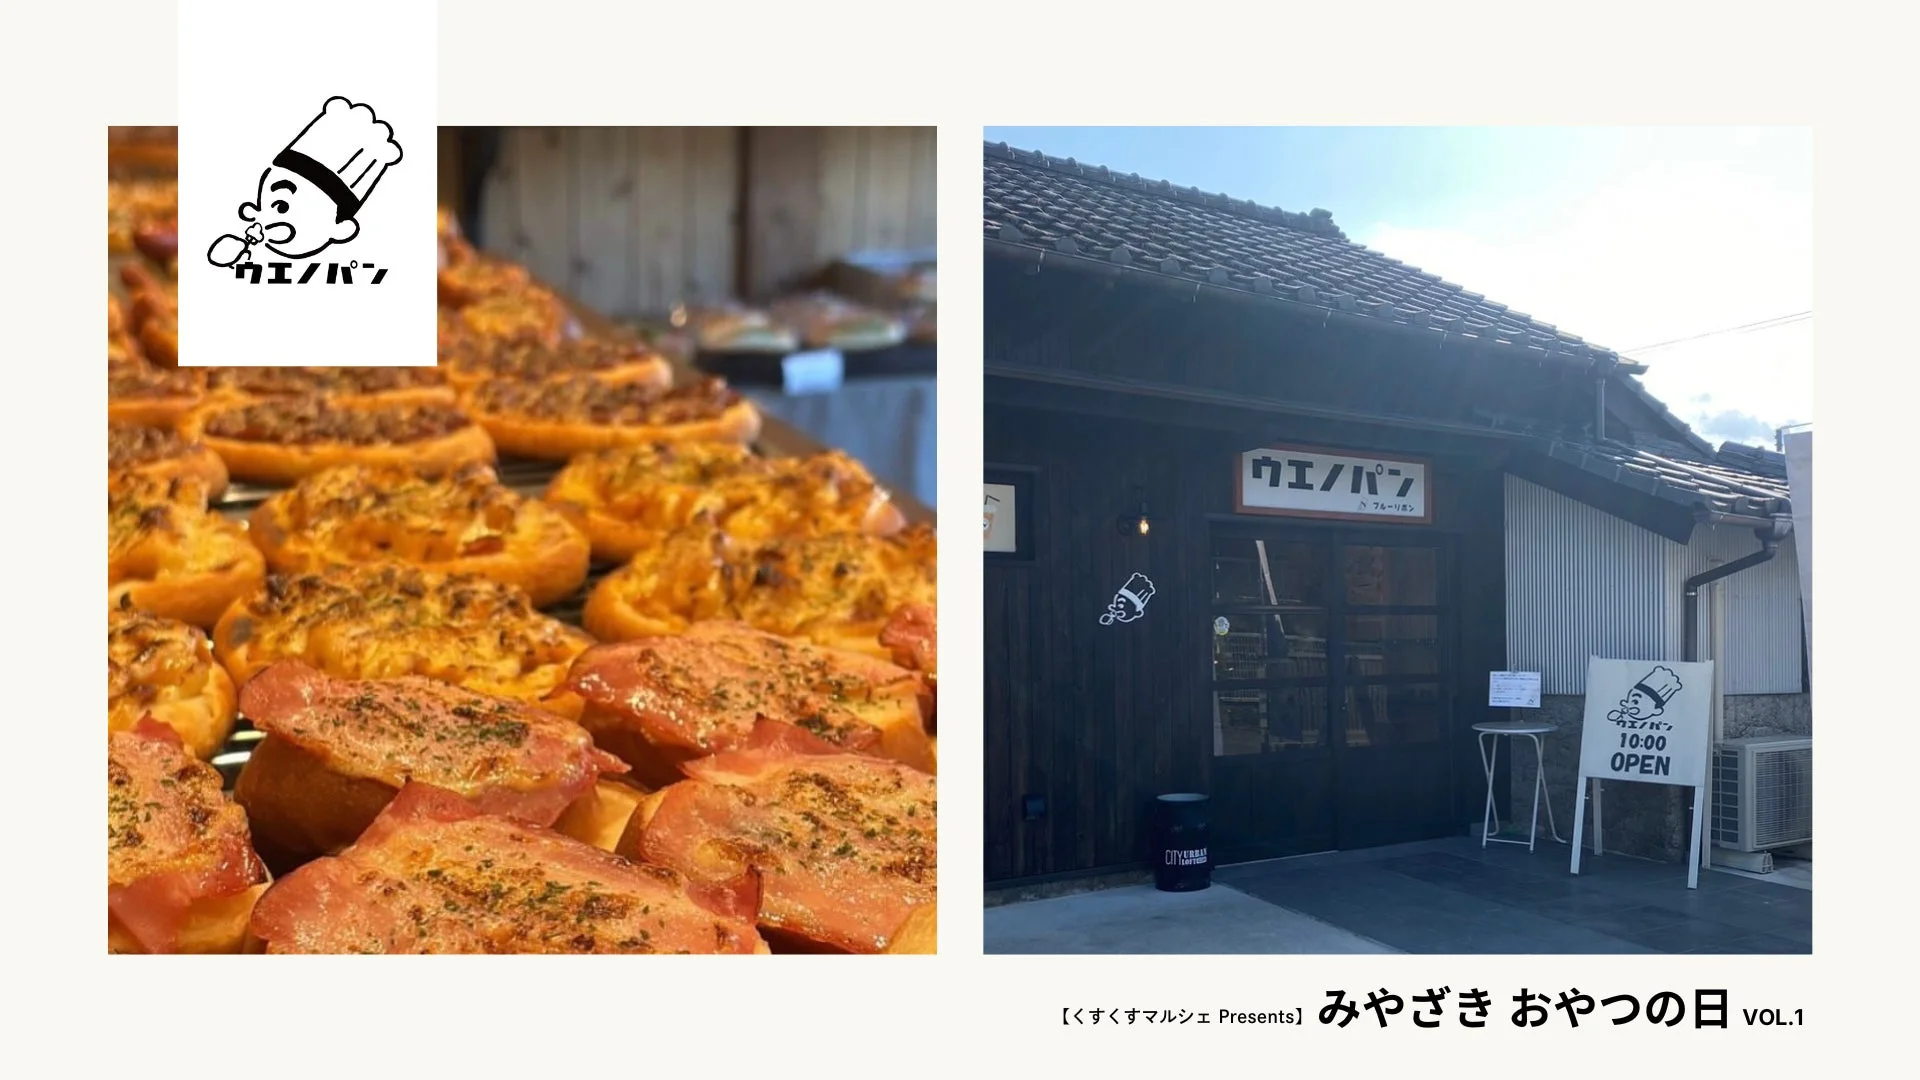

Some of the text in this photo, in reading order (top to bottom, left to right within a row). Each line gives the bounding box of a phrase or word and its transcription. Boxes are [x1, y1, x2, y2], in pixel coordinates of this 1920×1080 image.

[1252, 456, 1414, 497] ウエノパン
[1616, 720, 1673, 731] ウエノパン
[1620, 732, 1667, 751] 10:00
[1610, 752, 1671, 776] OPEN
[1165, 849, 1183, 865] CITY
